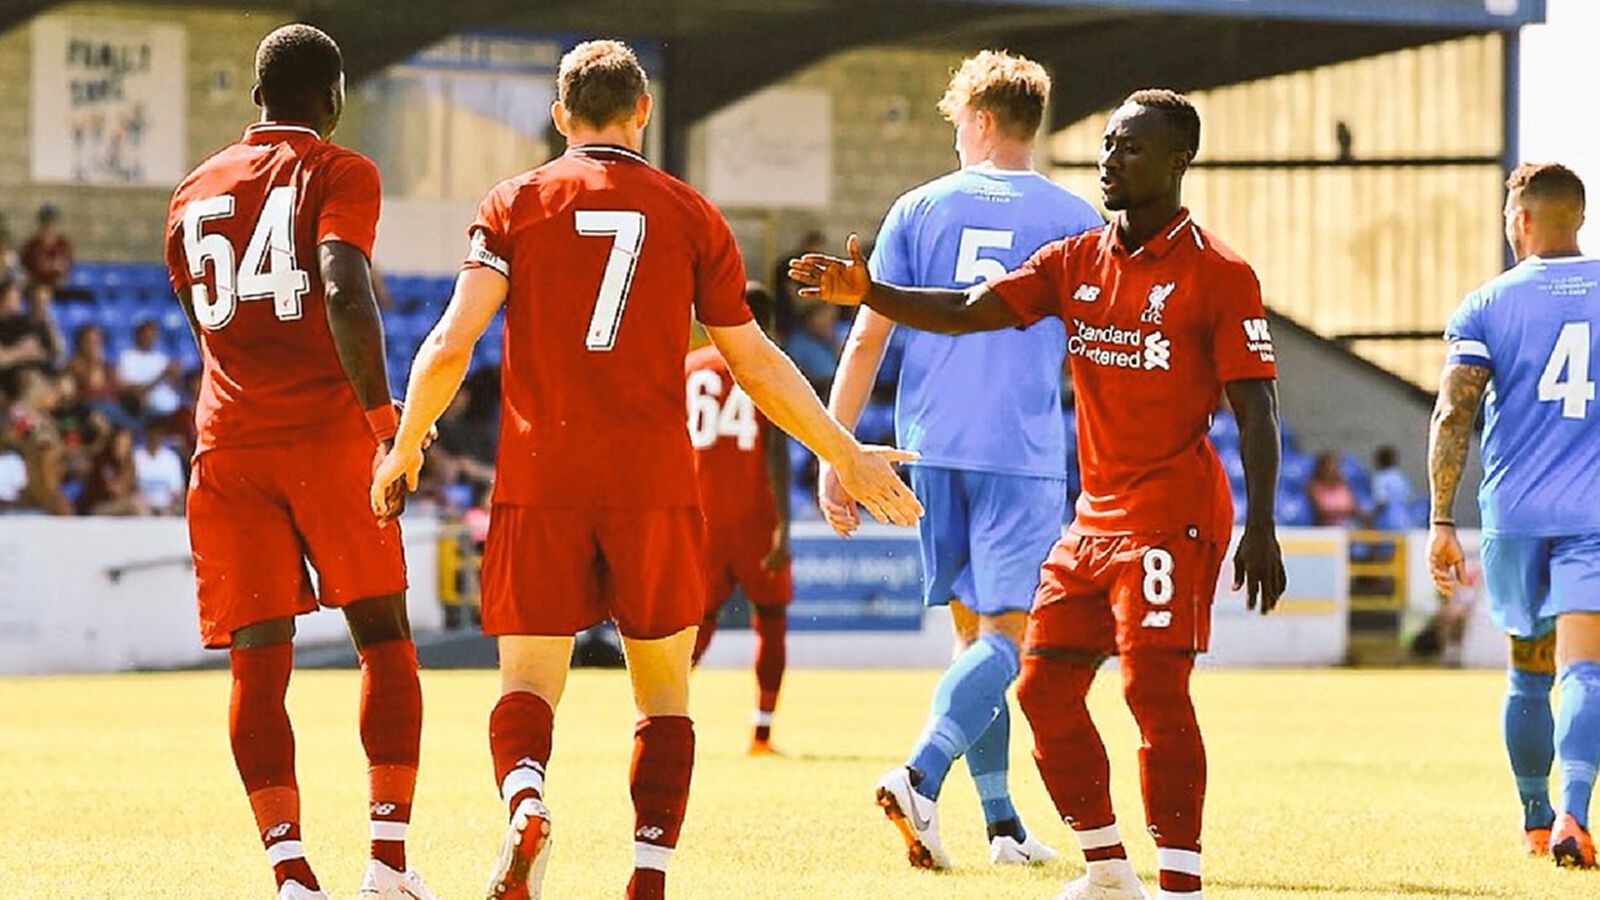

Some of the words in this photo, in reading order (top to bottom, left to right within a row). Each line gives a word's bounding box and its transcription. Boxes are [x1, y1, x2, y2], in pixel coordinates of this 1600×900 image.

[183, 185, 311, 331] 54
[574, 209, 647, 351] 7
[954, 226, 1015, 284] 5
[1068, 335, 1140, 369] Ctered
[1537, 321, 1596, 420] 4
[685, 368, 760, 451] 64
[1142, 547, 1176, 606] 8
